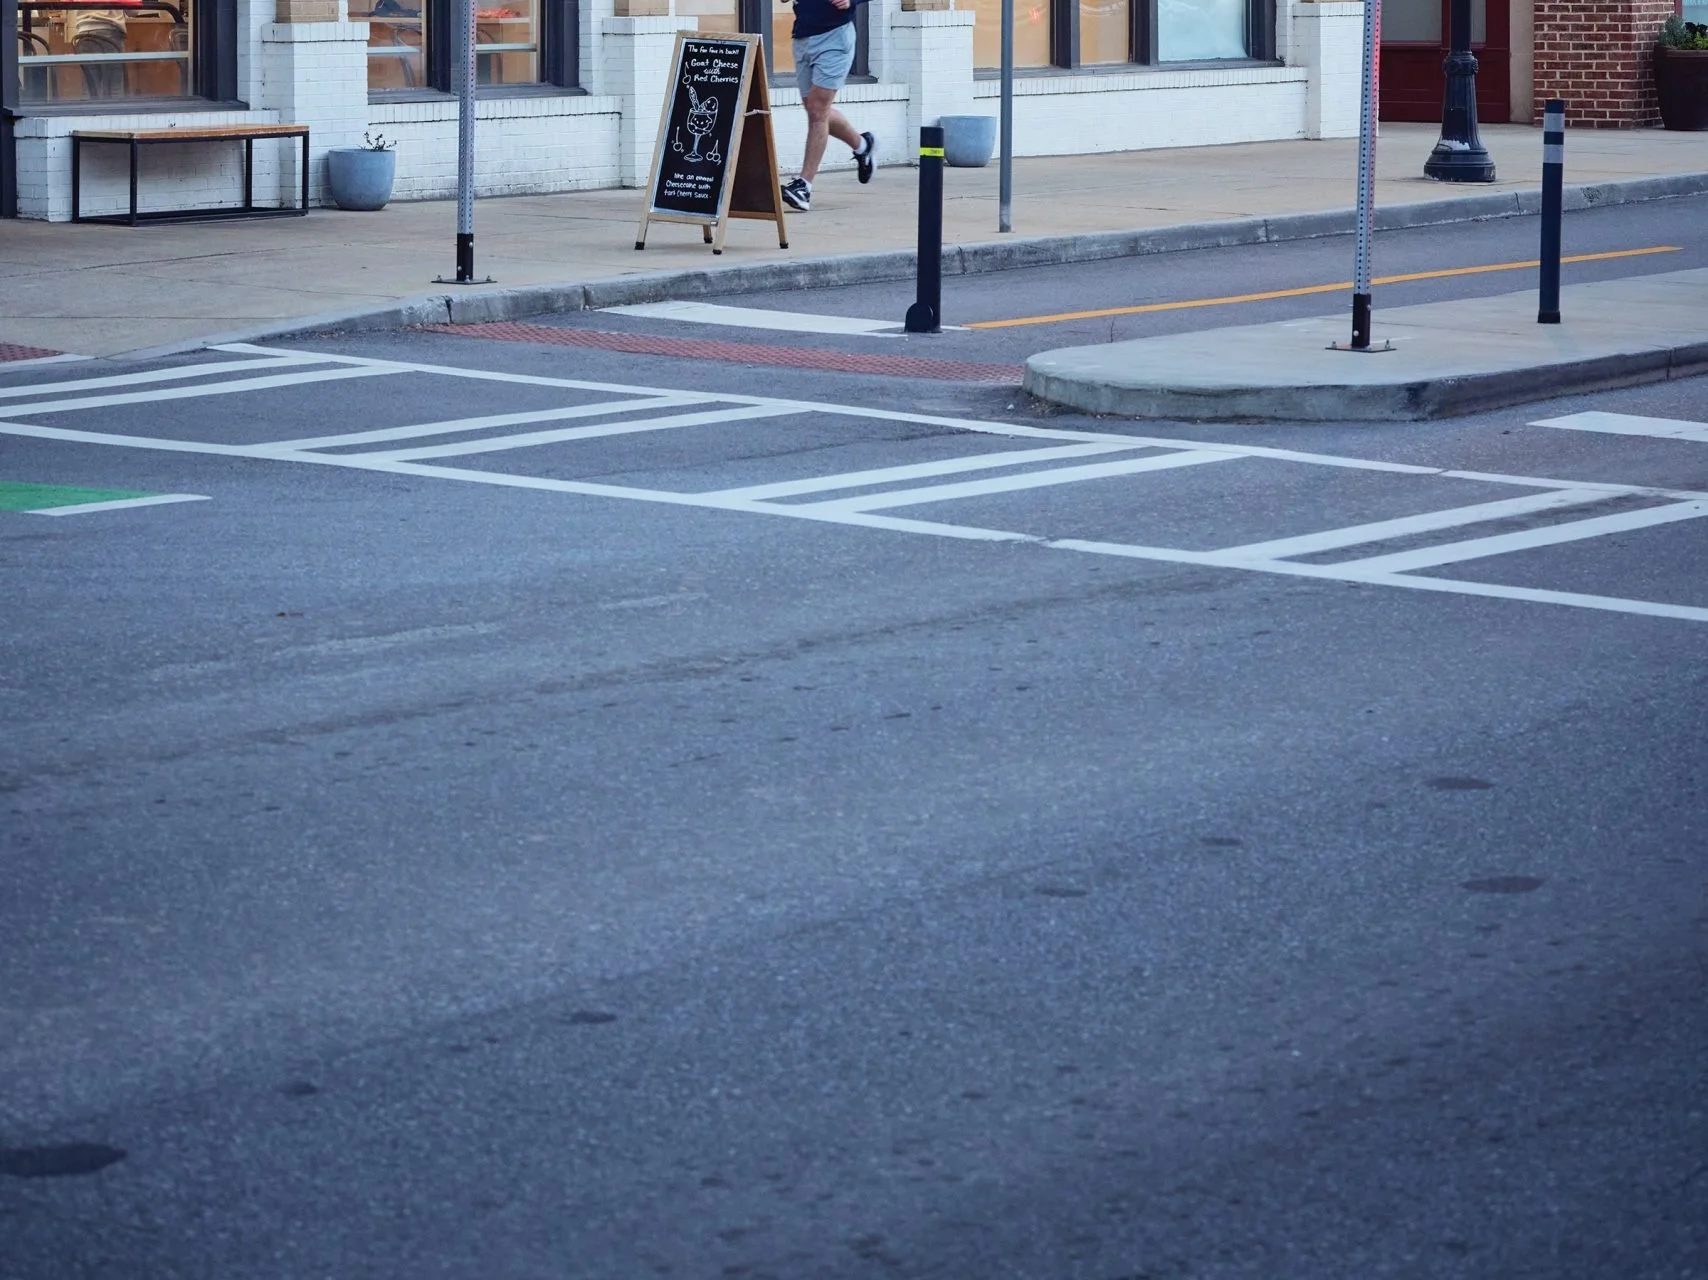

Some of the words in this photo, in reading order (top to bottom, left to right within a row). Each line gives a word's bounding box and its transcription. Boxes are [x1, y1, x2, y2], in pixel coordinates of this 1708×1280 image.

[687, 44, 698, 53] The
[690, 58, 710, 67] Goat
[712, 58, 739, 69] Cheese
[693, 74, 708, 82] Red
[710, 75, 739, 84] Cherries
